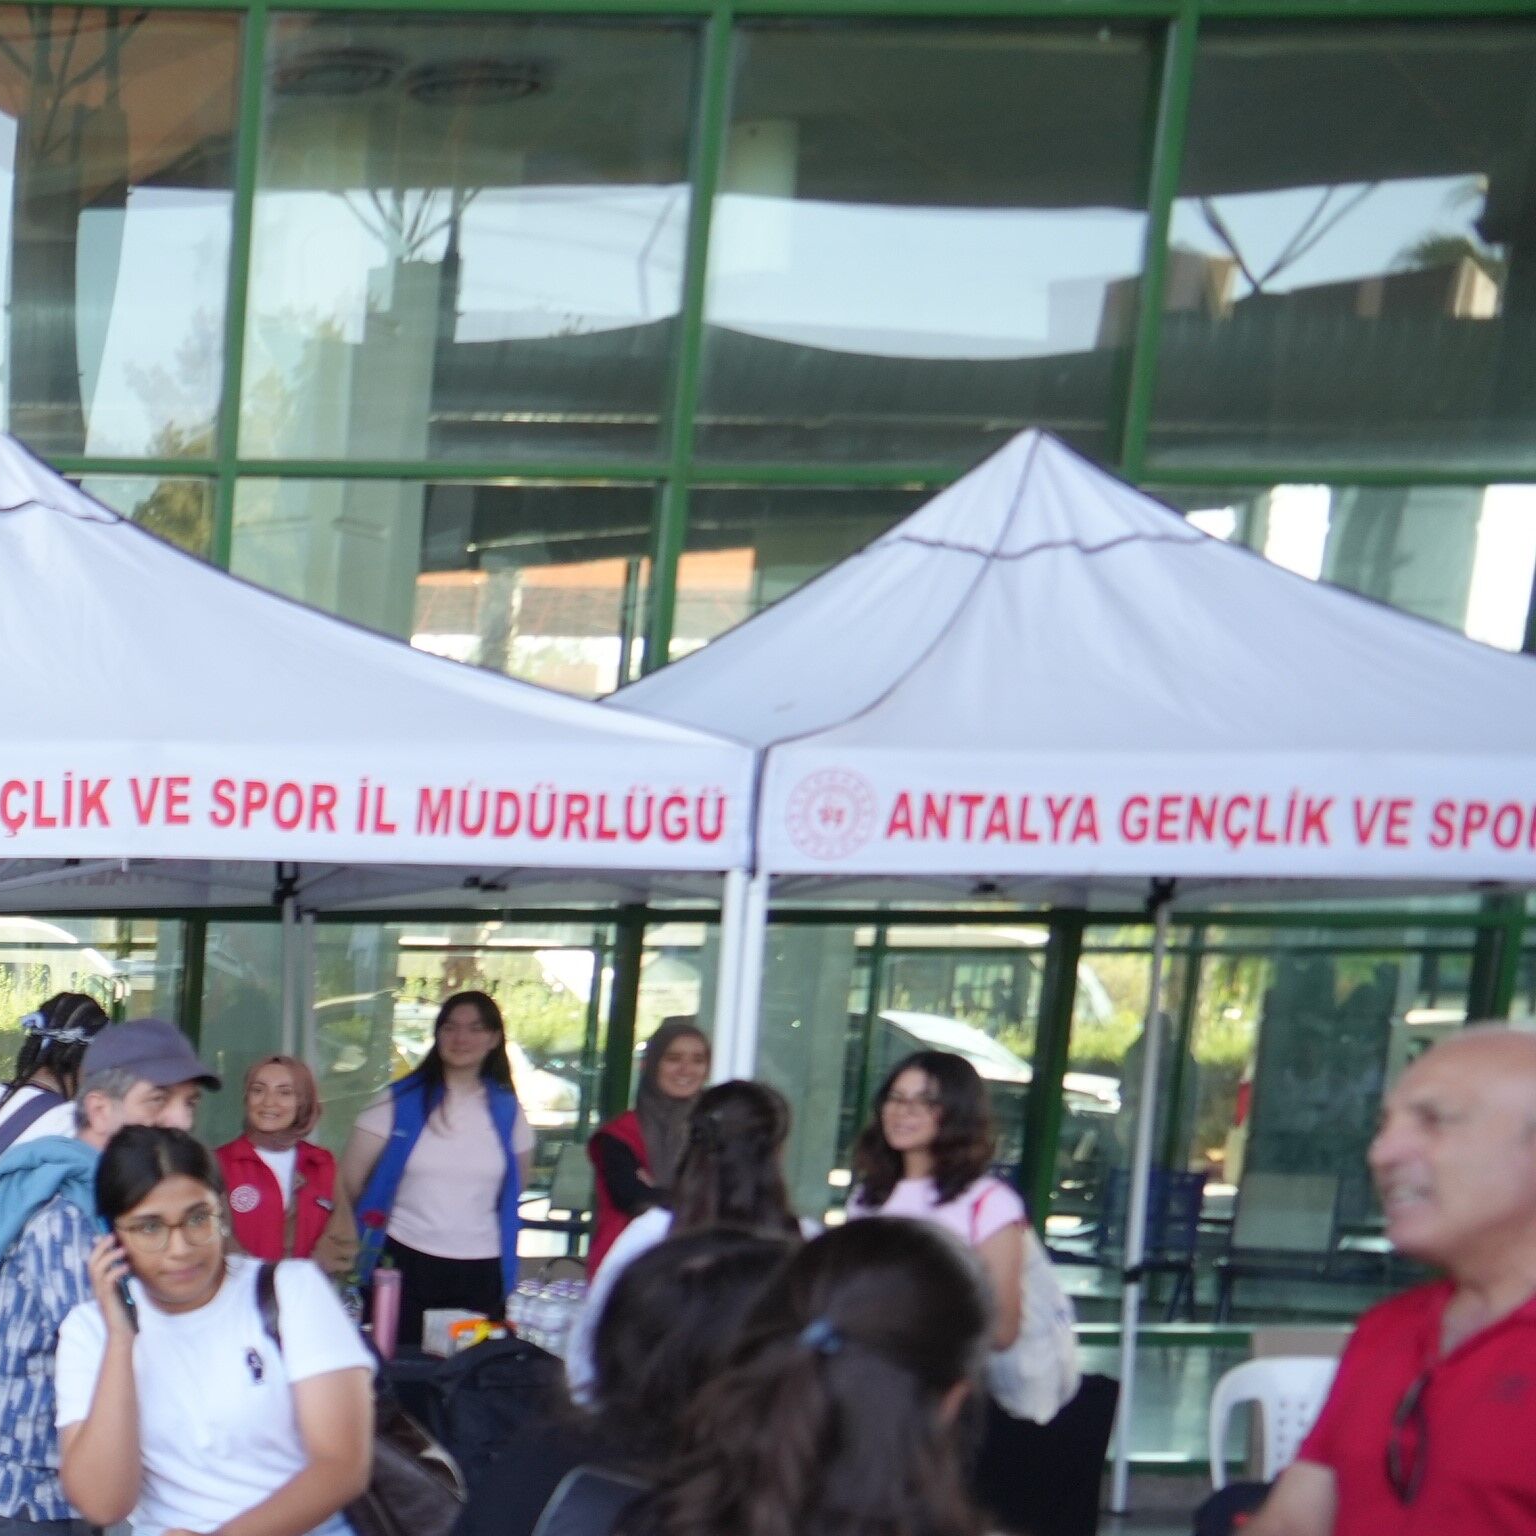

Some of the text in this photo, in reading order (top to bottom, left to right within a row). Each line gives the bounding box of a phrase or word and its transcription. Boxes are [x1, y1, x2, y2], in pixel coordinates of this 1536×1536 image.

[129, 776, 191, 825] VE
[209, 778, 338, 833] SPOR
[355, 776, 397, 835] İL
[416, 780, 726, 843] MÜDÜRLÜĞÜ
[884, 788, 1536, 851] ANTALYA GENÇLİK VE SPO
